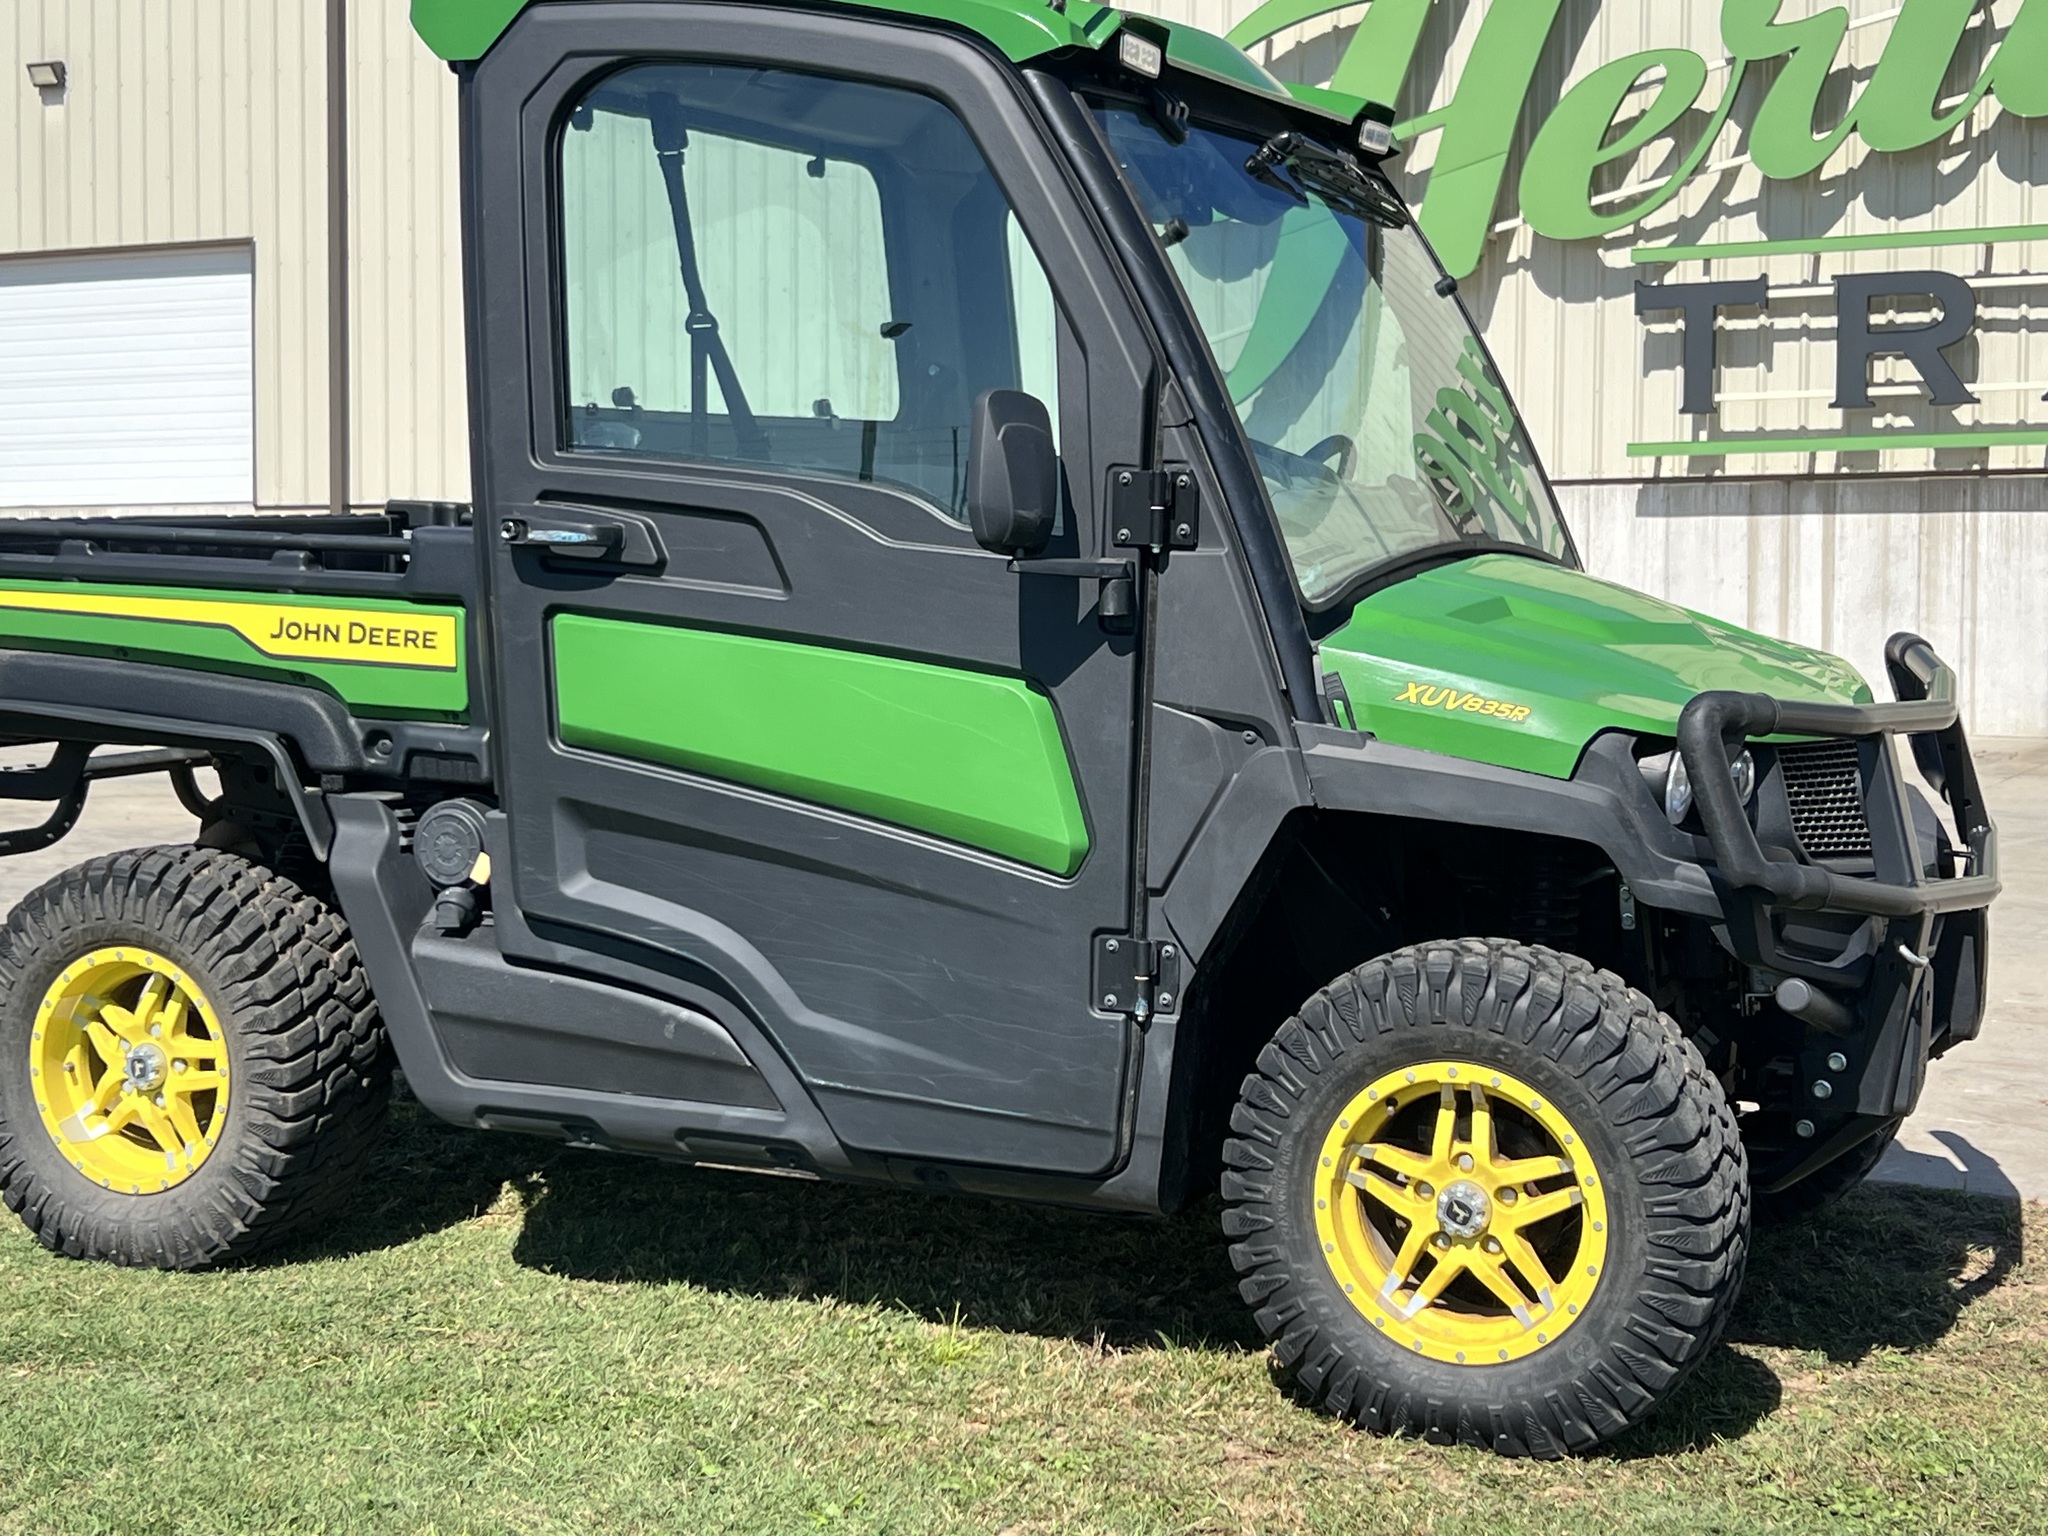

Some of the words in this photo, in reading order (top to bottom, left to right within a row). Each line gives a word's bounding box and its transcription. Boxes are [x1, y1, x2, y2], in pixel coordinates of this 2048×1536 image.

[1634, 270, 2048, 415] TR
[270, 617, 340, 642] JOHN
[348, 621, 438, 649] DEERE
[1393, 681, 1531, 722] XUV835R
